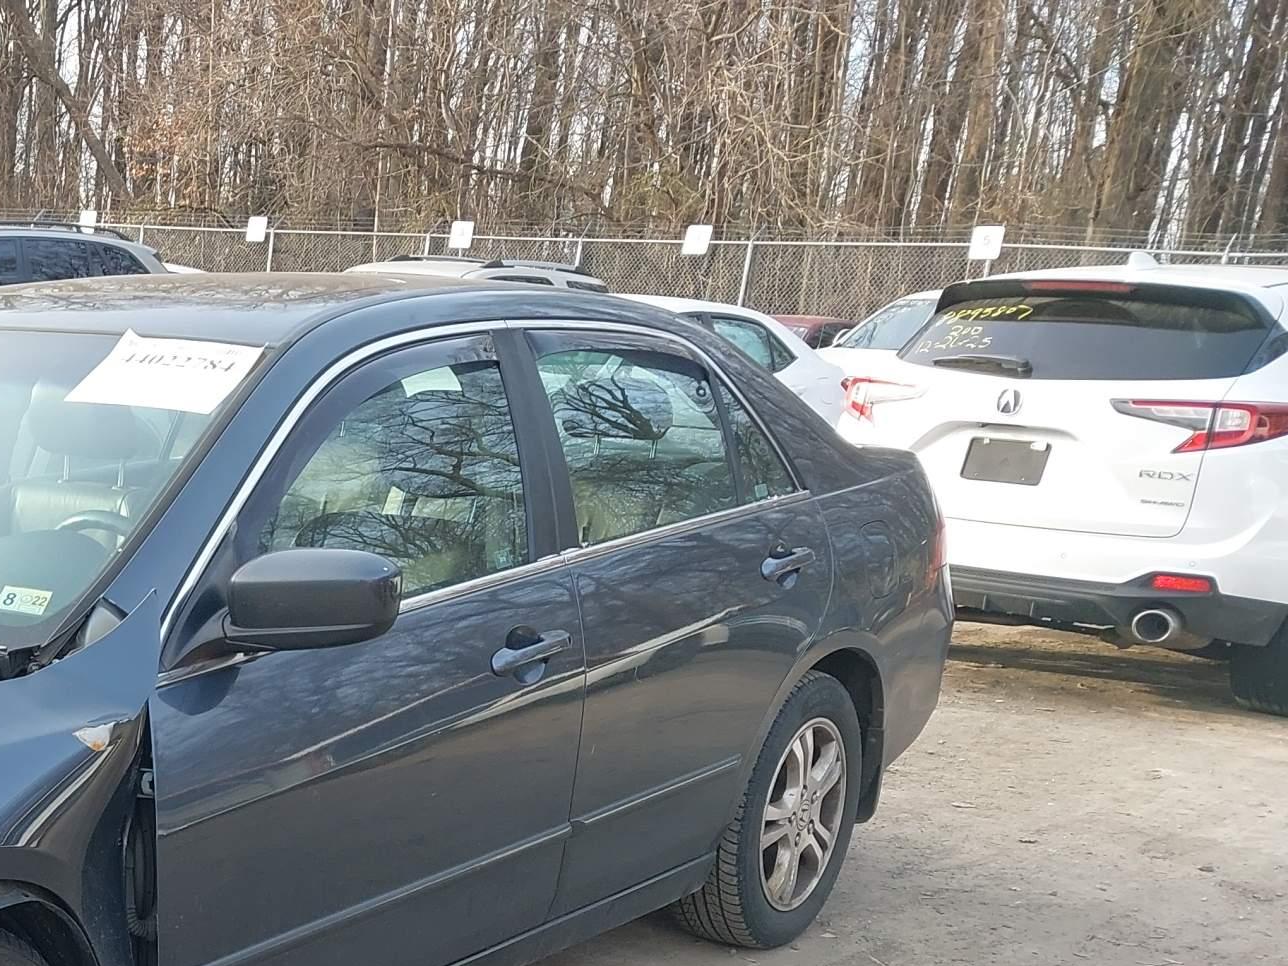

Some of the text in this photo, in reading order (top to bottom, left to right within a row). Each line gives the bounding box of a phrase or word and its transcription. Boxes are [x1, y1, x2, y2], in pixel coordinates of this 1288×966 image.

[1138, 469, 1195, 481] RDX
[2, 592, 48, 607] 8 22
